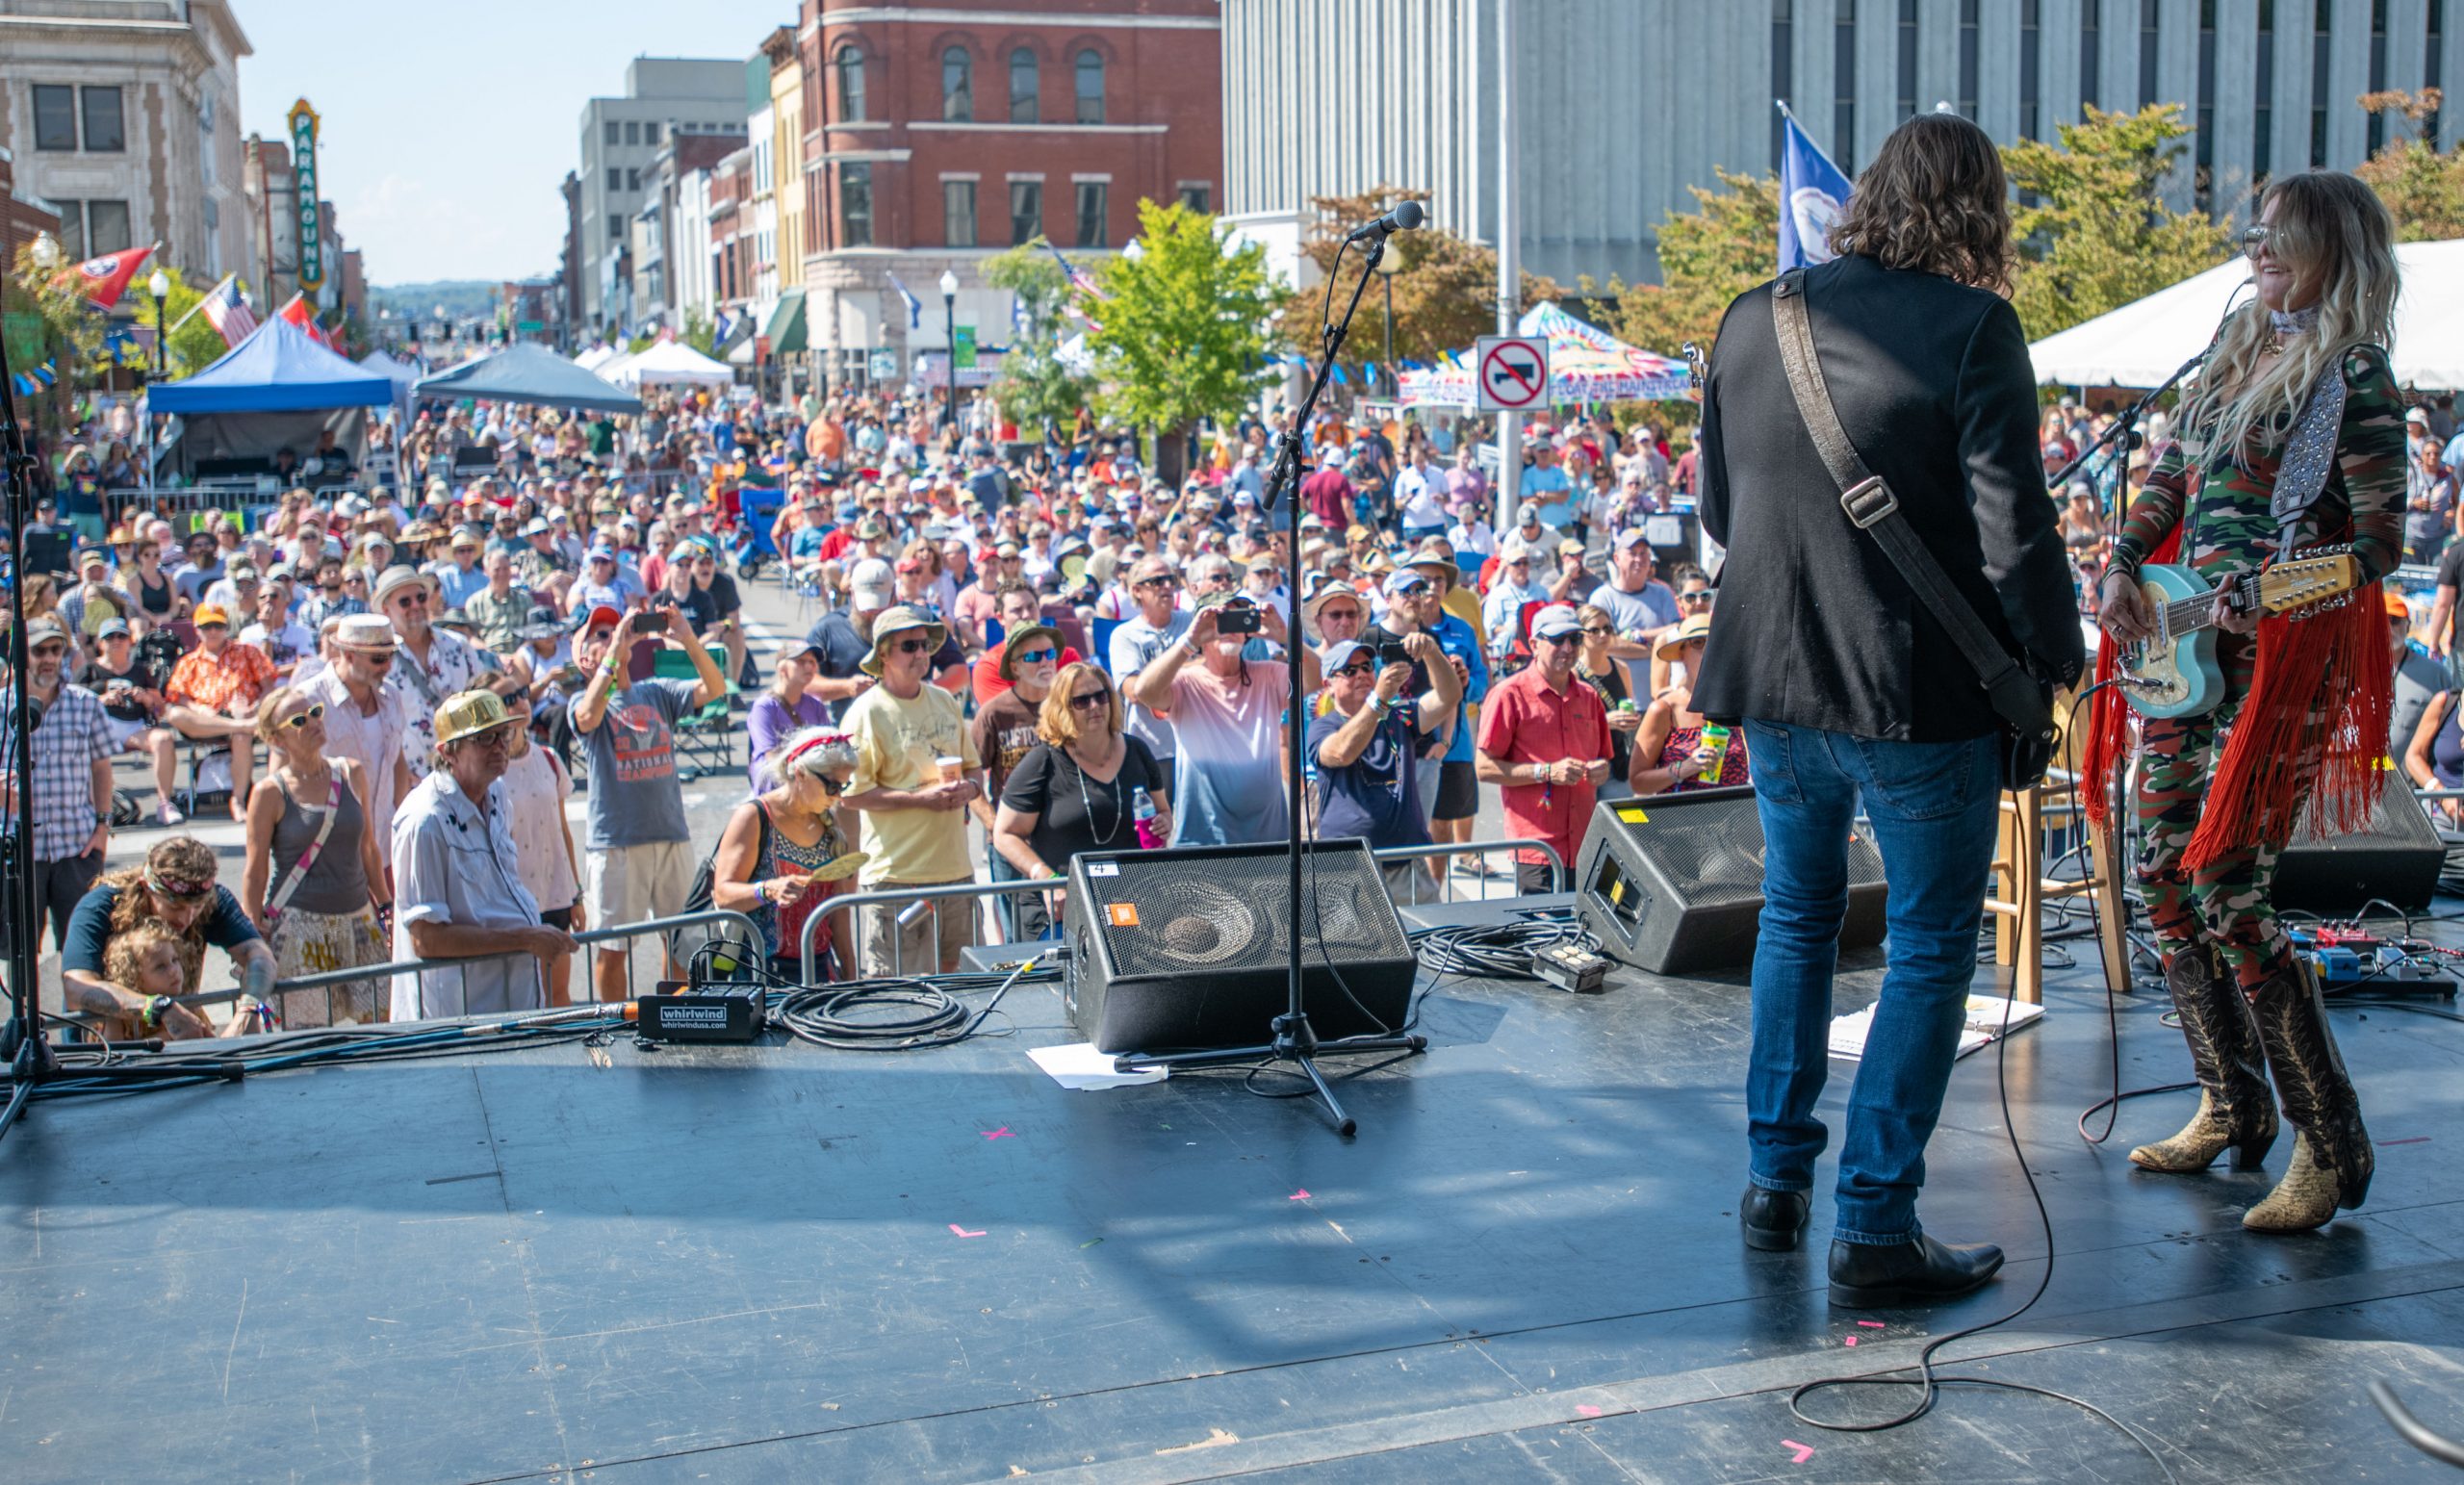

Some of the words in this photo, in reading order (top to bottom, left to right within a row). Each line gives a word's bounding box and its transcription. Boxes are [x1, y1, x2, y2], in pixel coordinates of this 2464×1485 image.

[295, 113, 319, 280] PARAMOUNT
[1094, 862, 1105, 874] 4
[663, 1009, 724, 1019] whirlwind
